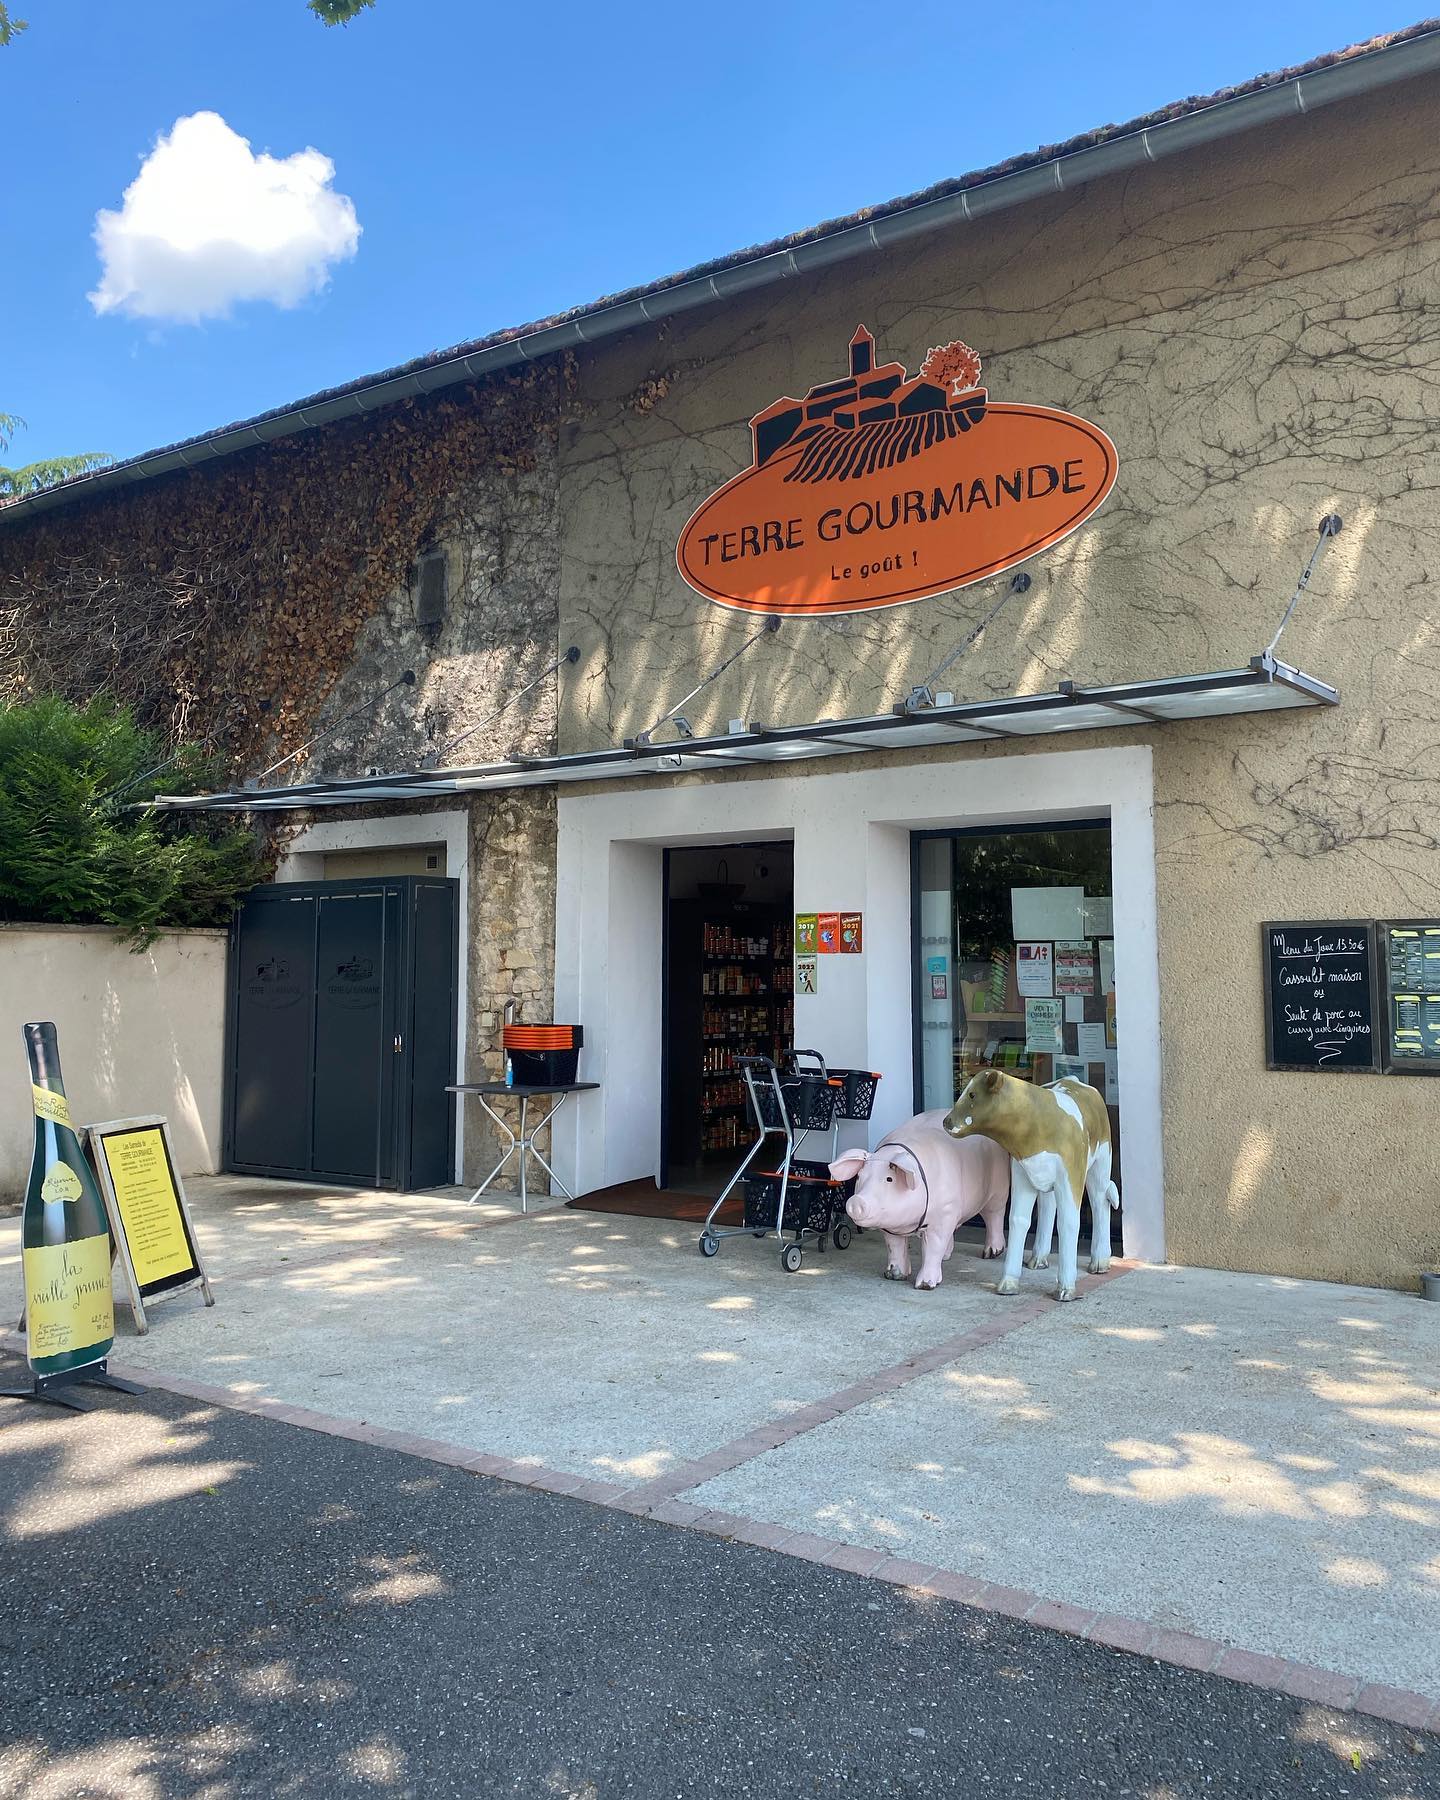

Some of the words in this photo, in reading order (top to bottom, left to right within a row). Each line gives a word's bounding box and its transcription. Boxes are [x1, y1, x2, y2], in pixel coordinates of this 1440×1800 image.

[698, 518, 804, 566] TERRE
[817, 459, 1086, 542] GOURMANDE
[831, 563, 852, 581] Le
[860, 553, 903, 579] goût
[1273, 933, 1301, 956] Menu
[1279, 966, 1325, 986] Cassoulet
[1328, 969, 1362, 982] maison
[1313, 988, 1325, 998] ou
[1312, 1008, 1322, 1021] de
[1324, 1010, 1346, 1028] porc
[1348, 1010, 1362, 1019] au
[62, 1249, 83, 1285] la
